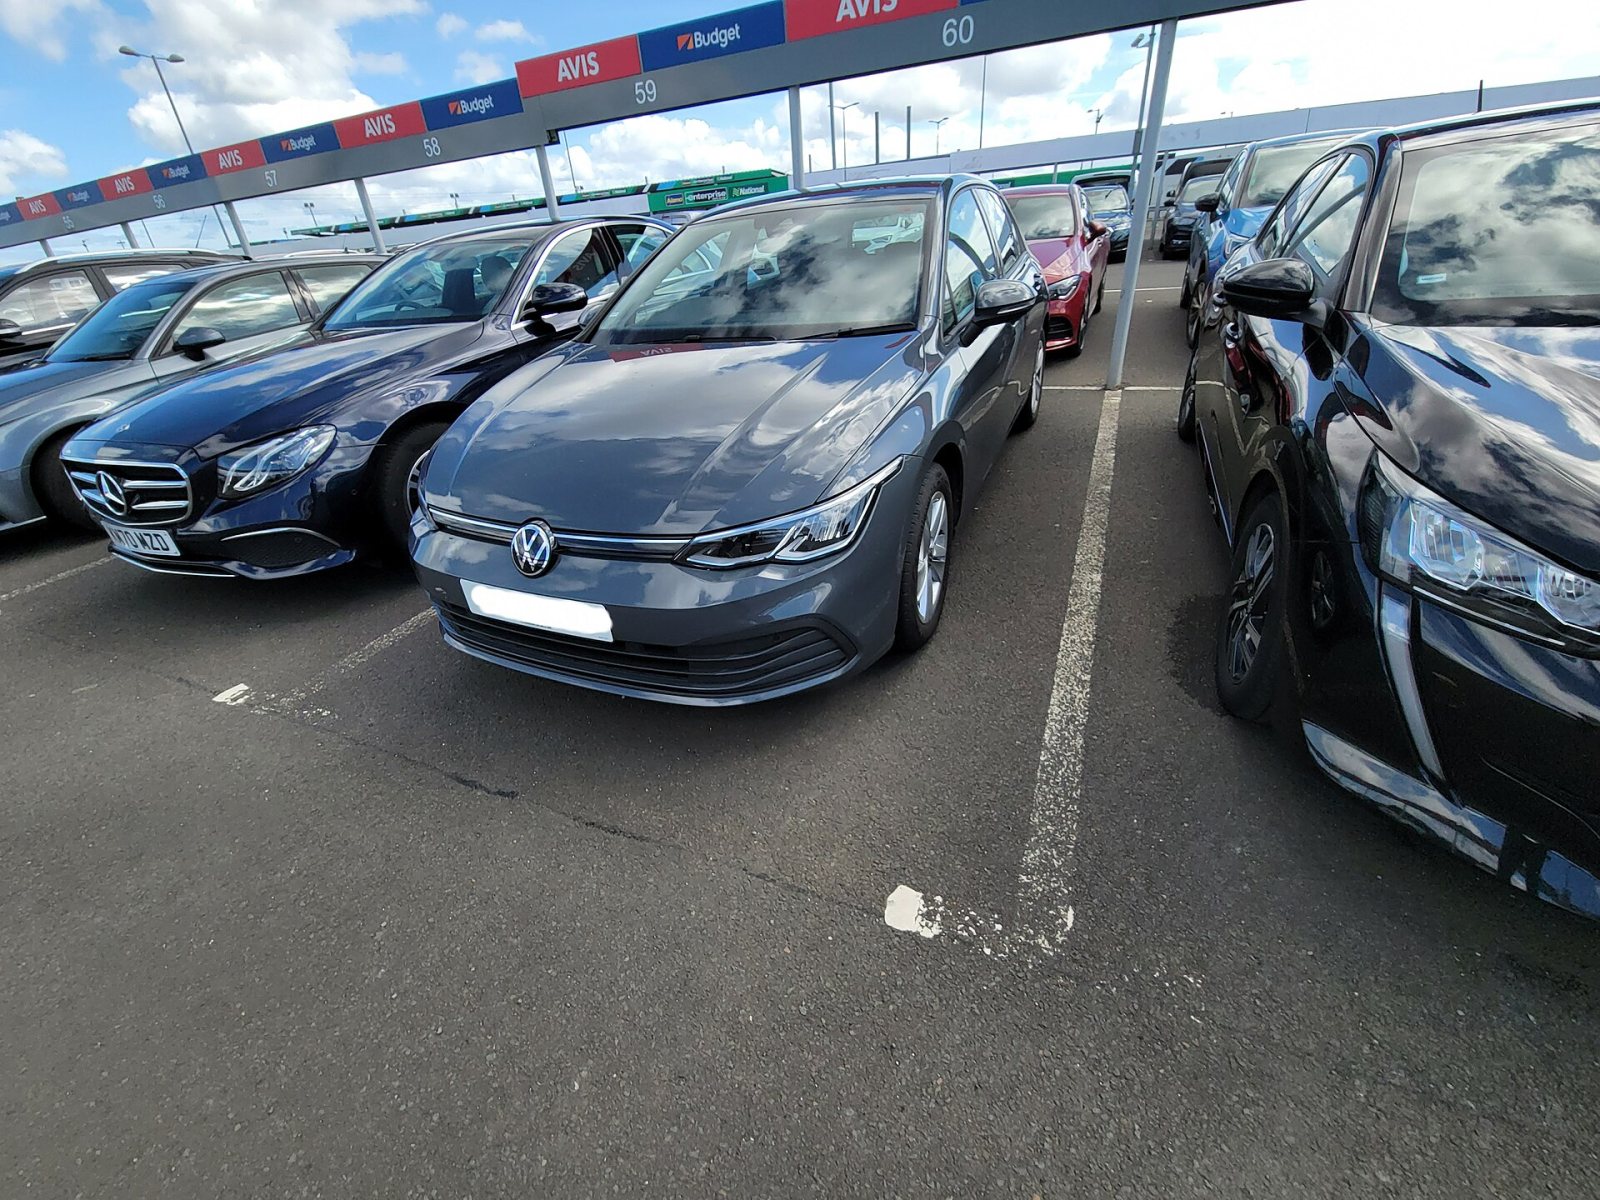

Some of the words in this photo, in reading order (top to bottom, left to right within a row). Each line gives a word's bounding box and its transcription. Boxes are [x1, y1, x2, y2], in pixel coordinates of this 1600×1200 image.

[694, 22, 741, 49] Budget
[942, 15, 974, 47] 60
[557, 51, 600, 82] AVIS
[635, 79, 657, 104] 59
[460, 94, 495, 114] Budget
[364, 113, 396, 138] AVIS
[289, 135, 317, 151] Budget
[423, 137, 441, 157] 58
[218, 149, 243, 170] AVIS
[114, 176, 135, 194] AVIS
[264, 170, 278, 187] 57
[153, 194, 166, 209] 56
[686, 190, 727, 202] enterprise
[28, 199, 47, 215] AVIS
